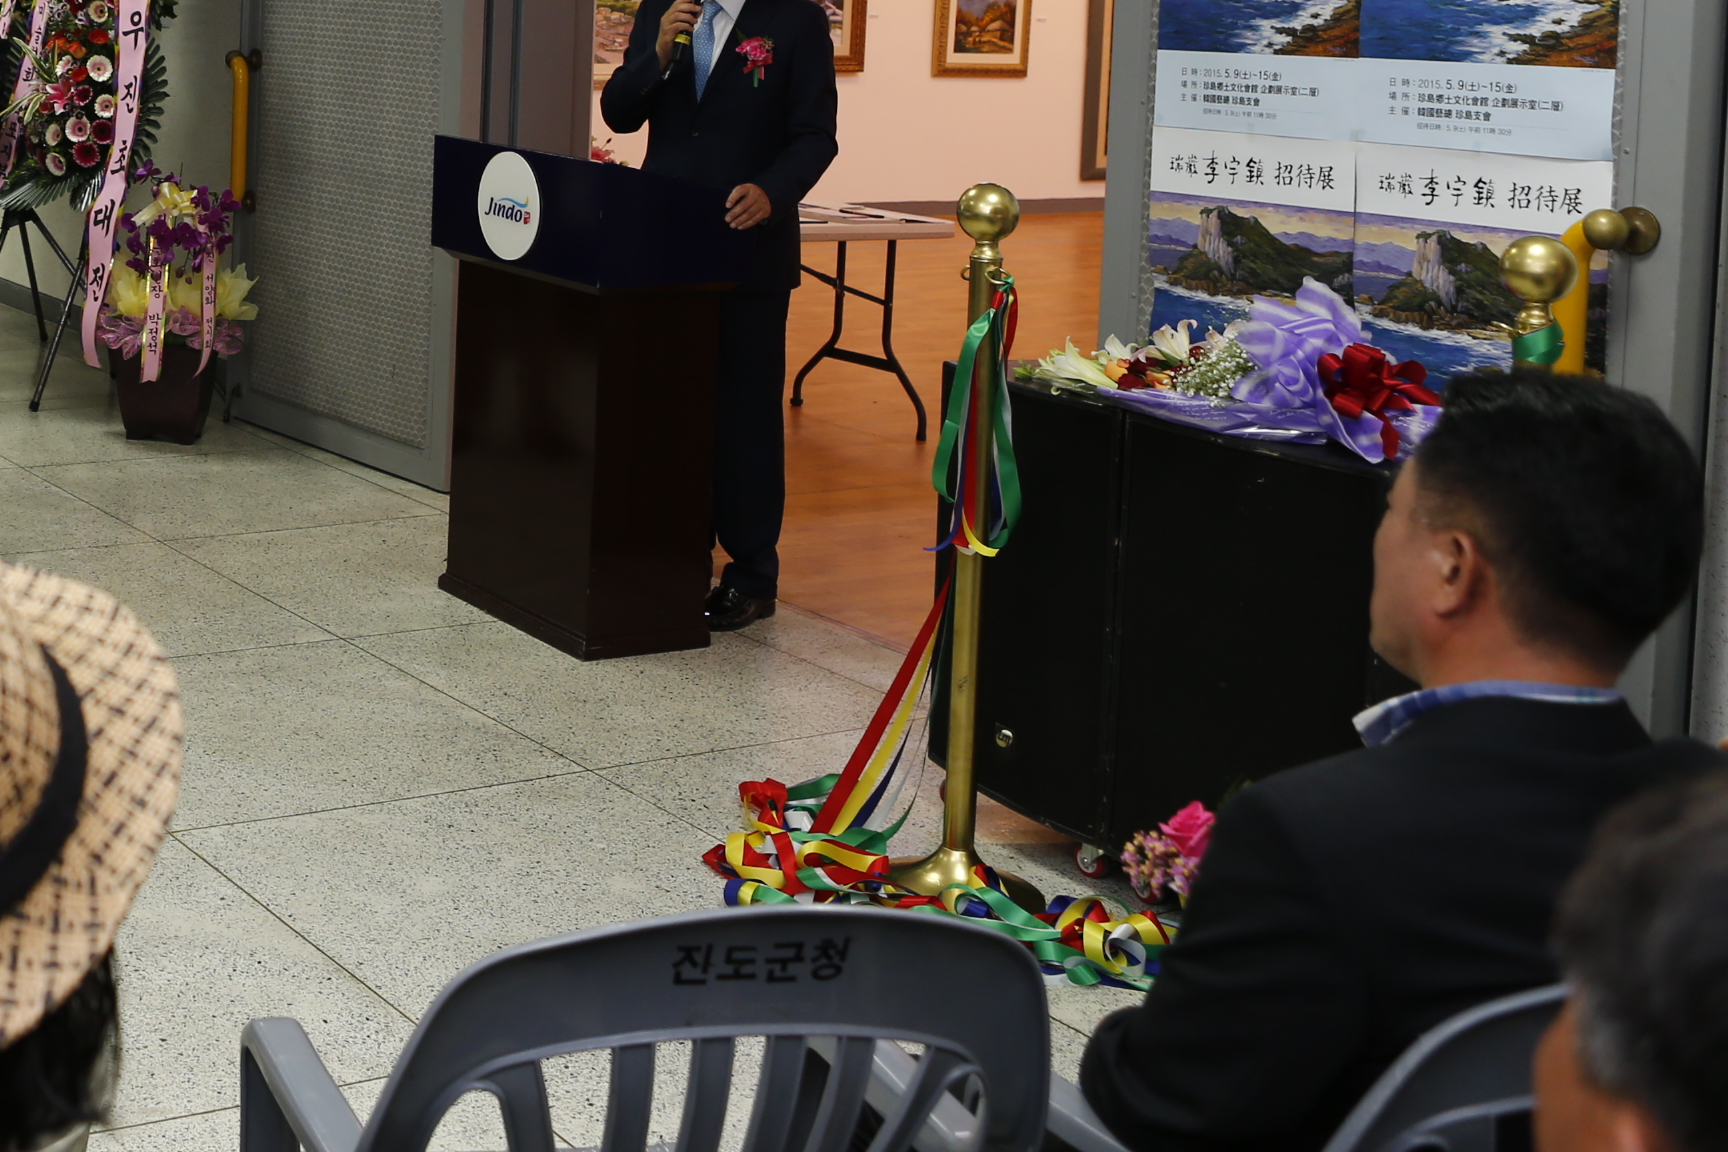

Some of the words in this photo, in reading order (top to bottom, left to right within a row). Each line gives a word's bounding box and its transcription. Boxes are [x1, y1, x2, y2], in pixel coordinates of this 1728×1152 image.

[1274, 161, 1335, 190] 招待展
[484, 197, 522, 223] Jindo
[1507, 181, 1583, 215] 招待展
[146, 312, 162, 355] 박정석
[672, 936, 851, 986] 진도군청
